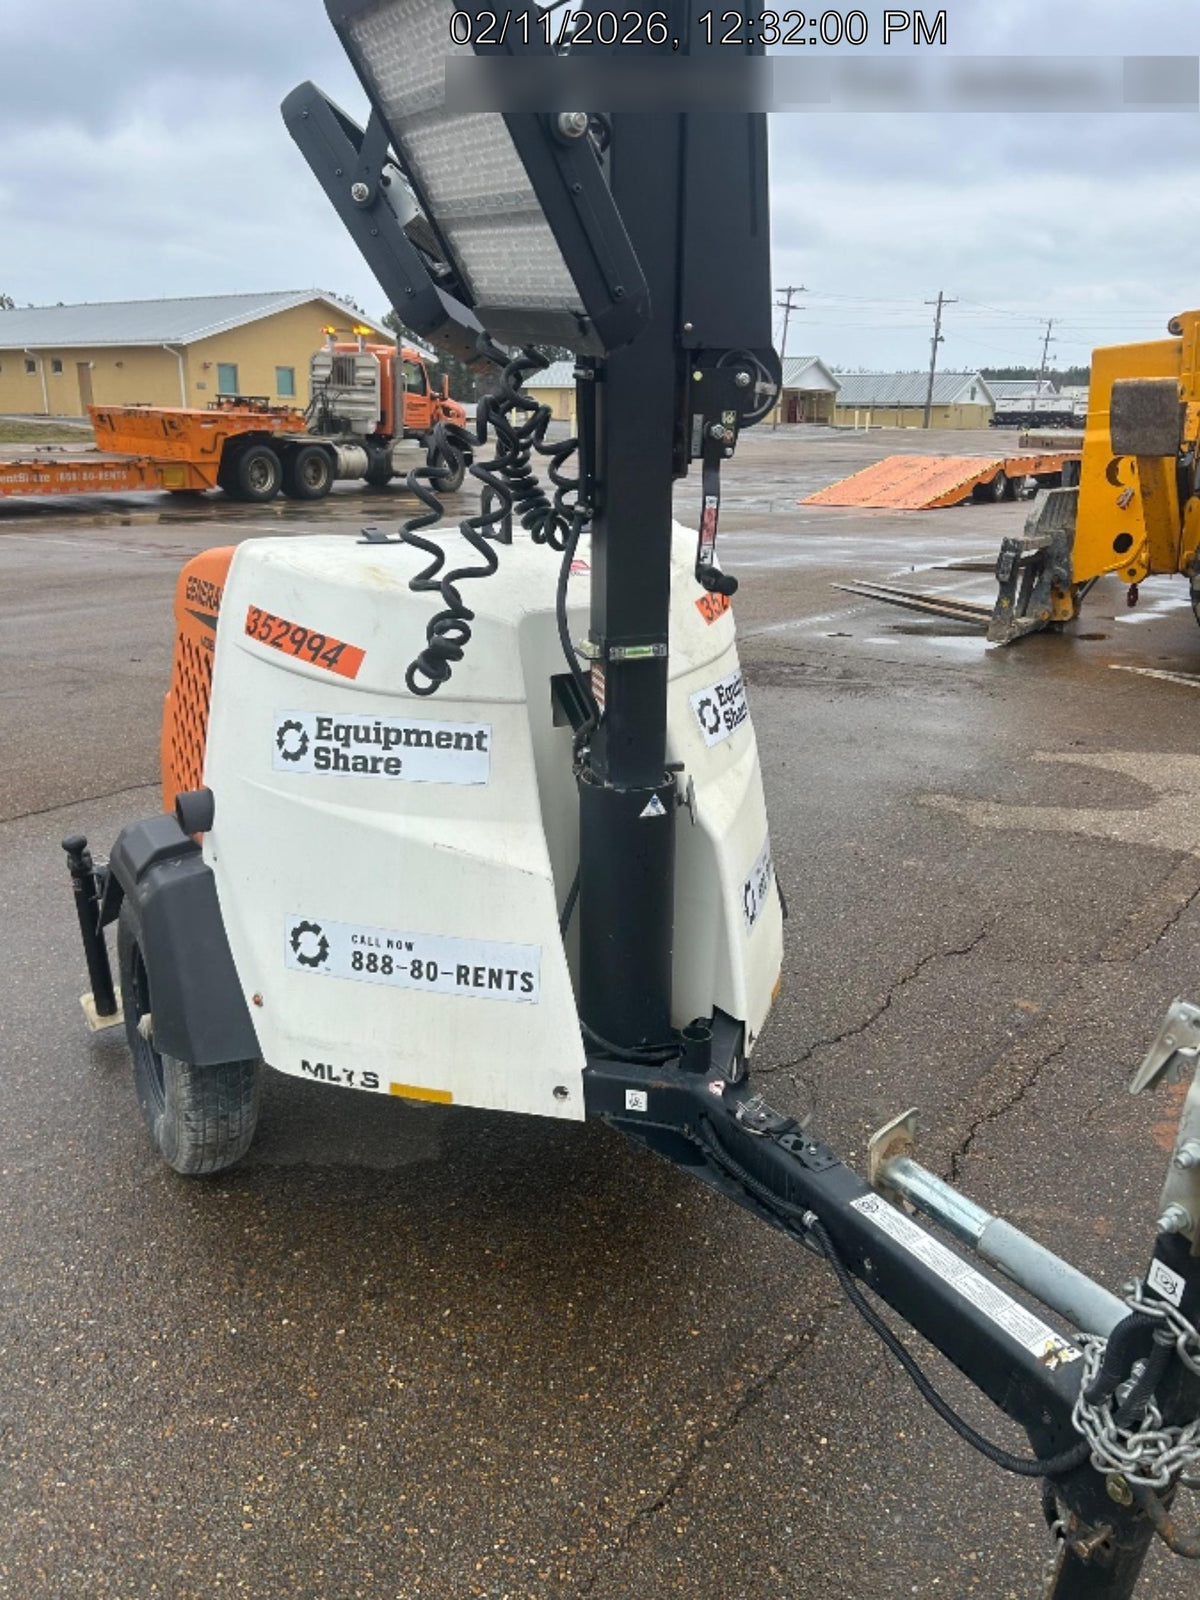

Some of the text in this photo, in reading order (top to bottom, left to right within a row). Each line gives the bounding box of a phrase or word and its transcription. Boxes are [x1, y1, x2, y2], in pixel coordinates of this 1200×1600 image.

[246, 606, 347, 669] 352994
[314, 716, 489, 753] Equipment
[313, 745, 402, 776] Share
[351, 934, 415, 952] CALL NOW
[351, 950, 535, 993] 888-80-RENTS
